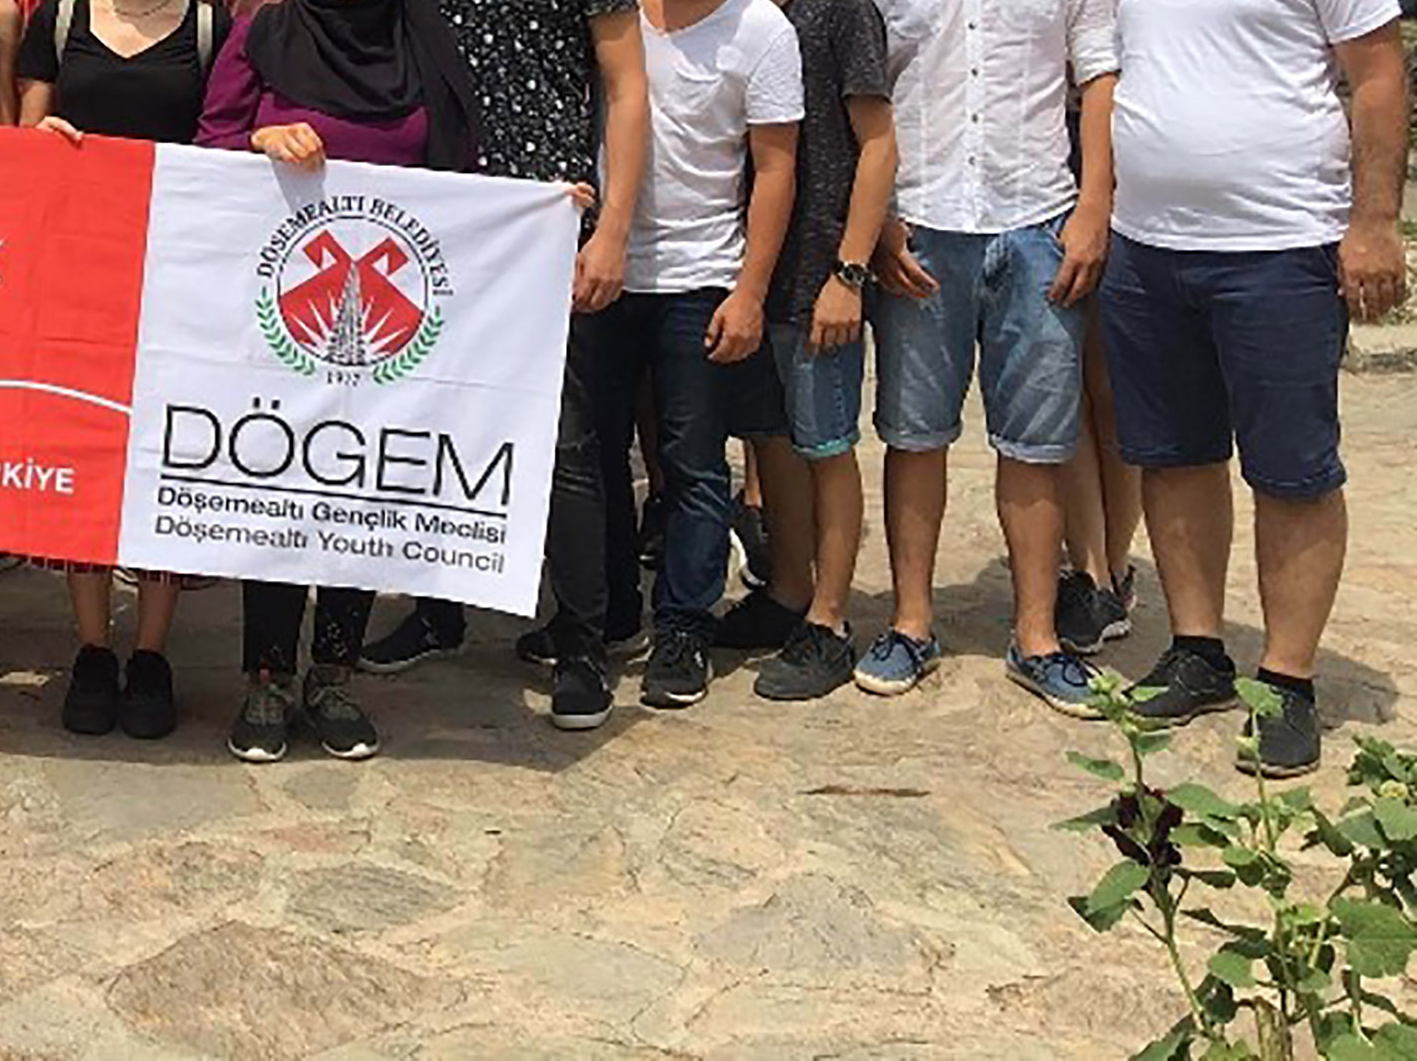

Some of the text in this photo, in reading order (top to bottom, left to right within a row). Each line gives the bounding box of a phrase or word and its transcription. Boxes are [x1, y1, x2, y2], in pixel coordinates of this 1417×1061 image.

[161, 396, 515, 506] DÖGEM
[155, 515, 505, 574] Döşemealtı Youth Council
[157, 486, 507, 545] Döşemealtı Gençlik Meclisi
